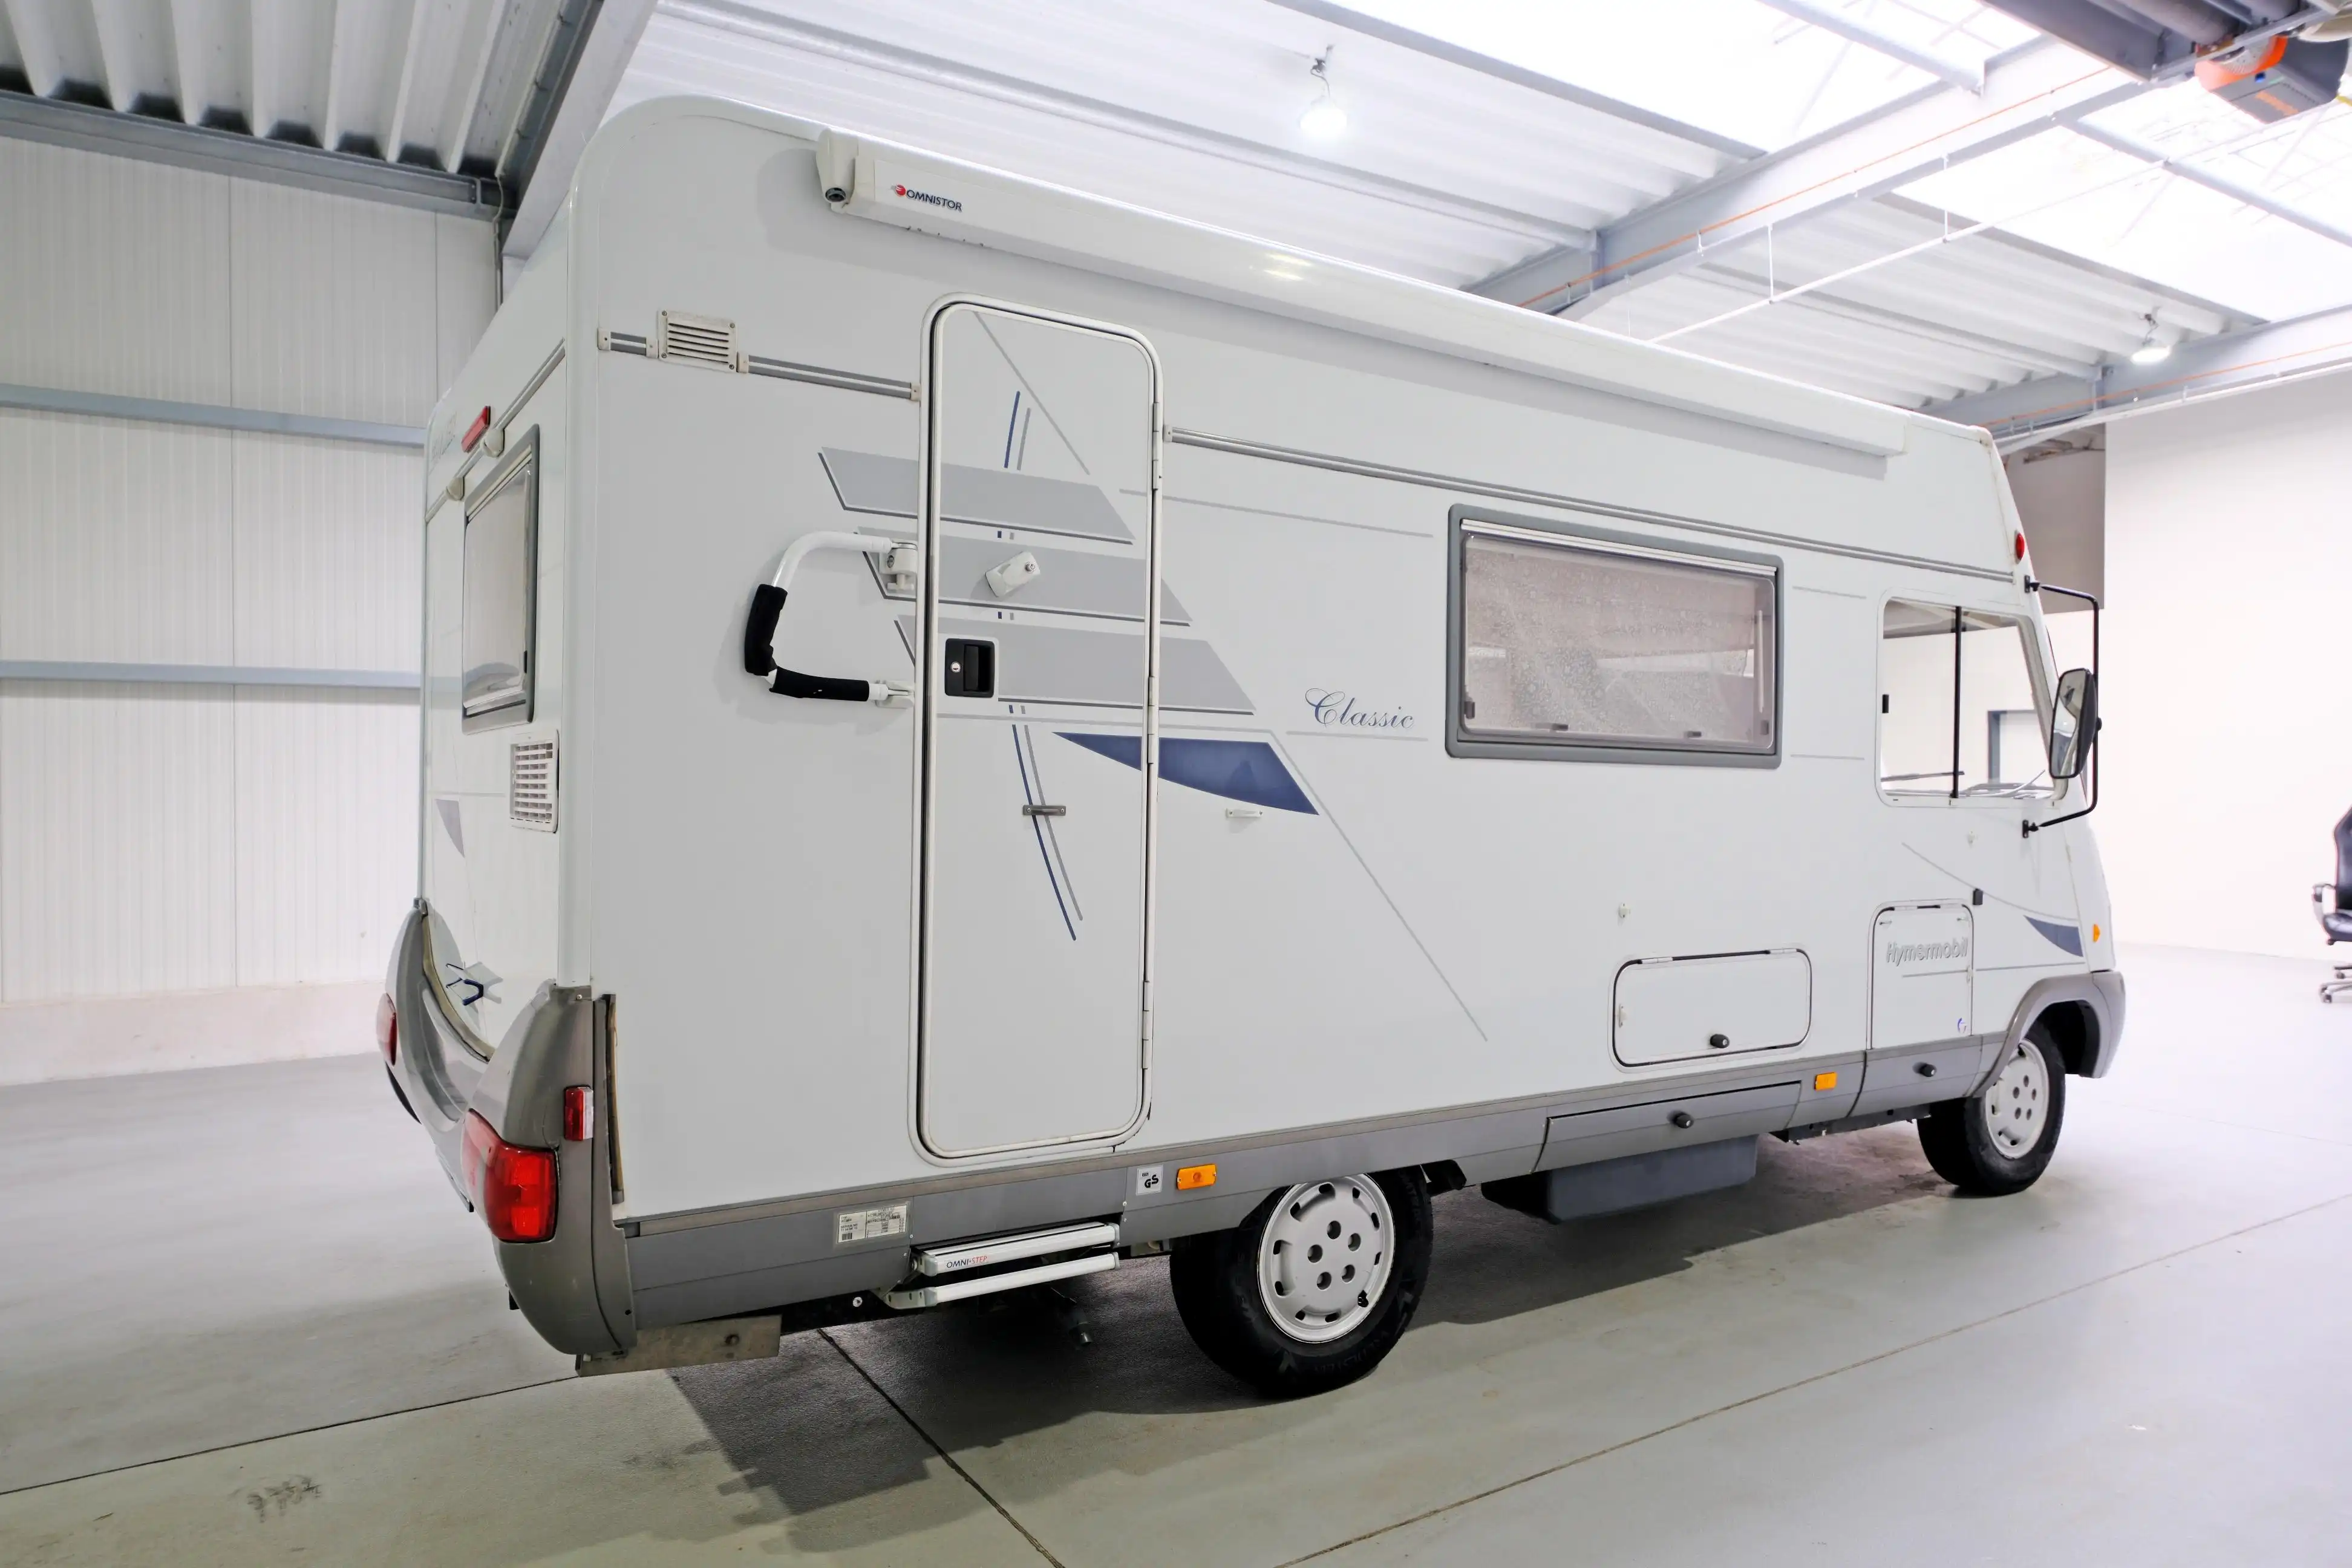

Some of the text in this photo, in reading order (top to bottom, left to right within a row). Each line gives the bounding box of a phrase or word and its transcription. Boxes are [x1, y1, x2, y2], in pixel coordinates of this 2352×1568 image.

[906, 189, 962, 212] OMNISTOR
[1305, 687, 1414, 728] Classic
[1886, 937, 1969, 967] Hymermobil
[1144, 1174, 1158, 1188] GS
